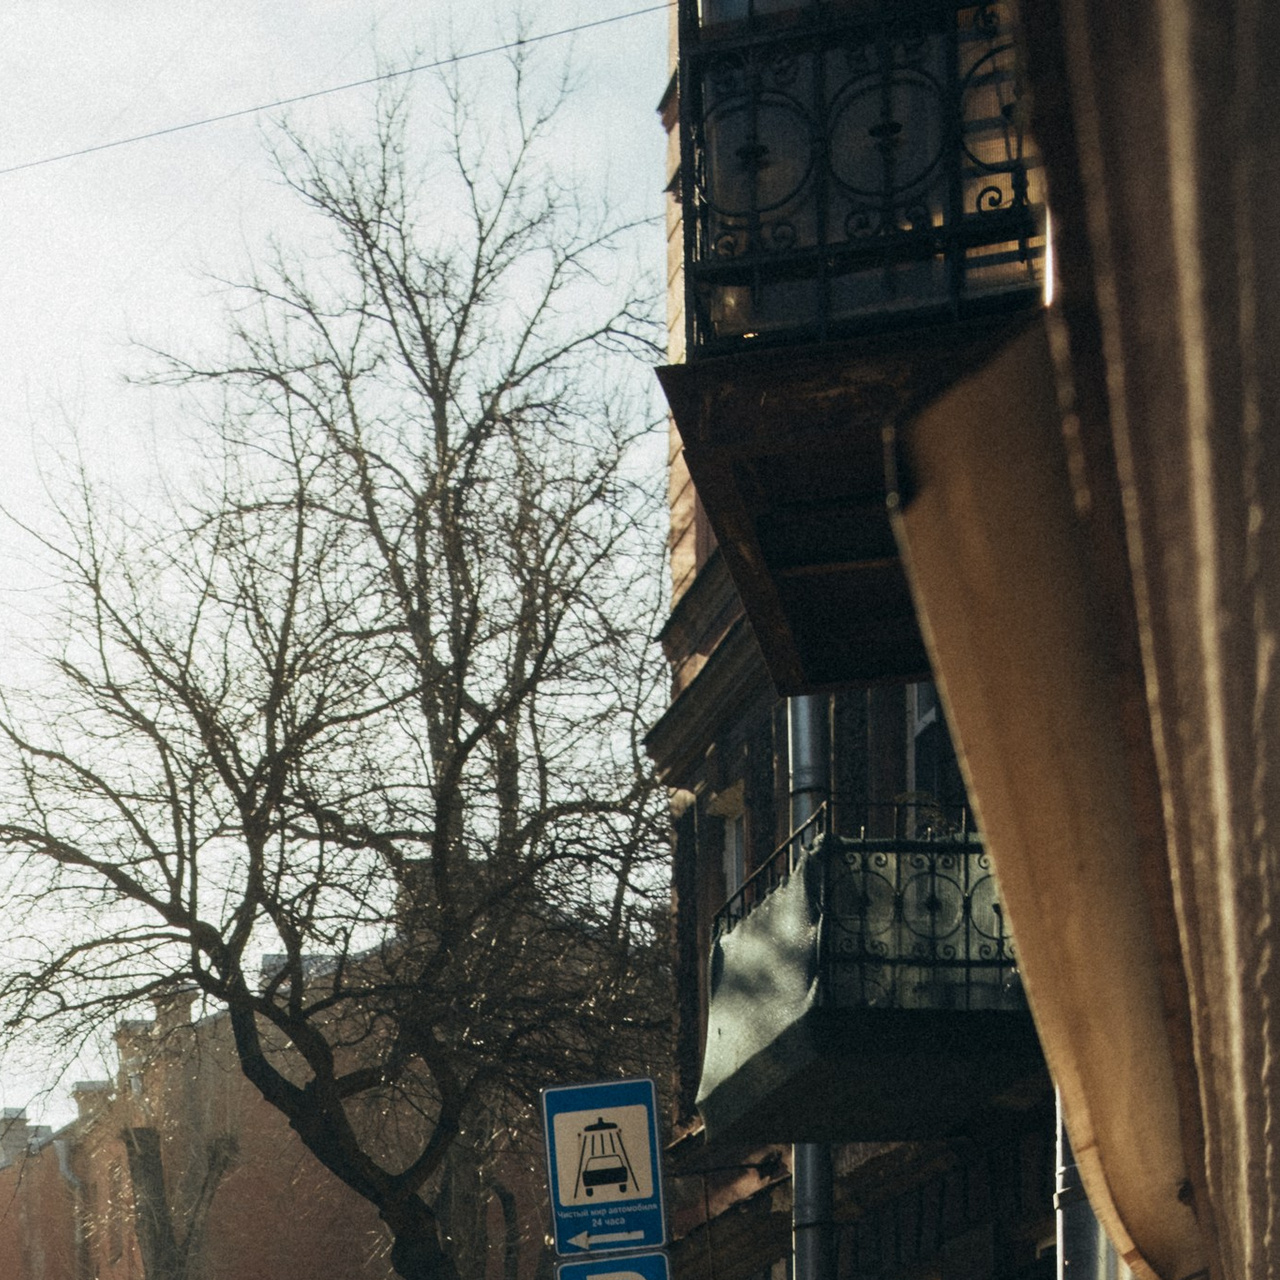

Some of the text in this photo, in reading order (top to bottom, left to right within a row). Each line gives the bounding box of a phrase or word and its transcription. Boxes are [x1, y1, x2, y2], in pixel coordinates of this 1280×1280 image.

[557, 1203, 658, 1219] Чистый мир автомобиля
[592, 1217, 626, 1228] 24 часа
